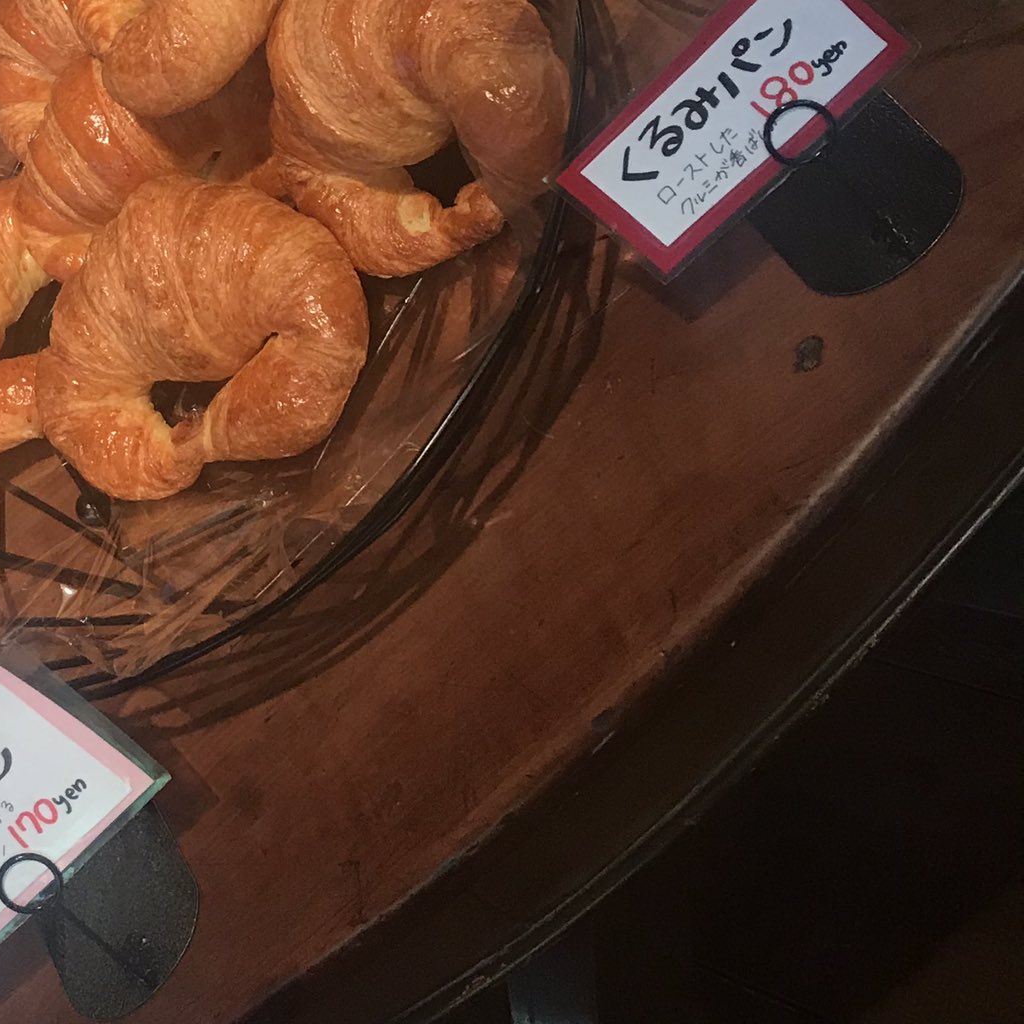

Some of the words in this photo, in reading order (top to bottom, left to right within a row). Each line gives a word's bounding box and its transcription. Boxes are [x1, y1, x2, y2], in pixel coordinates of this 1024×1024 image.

[621, 18, 794, 182] くるみパン
